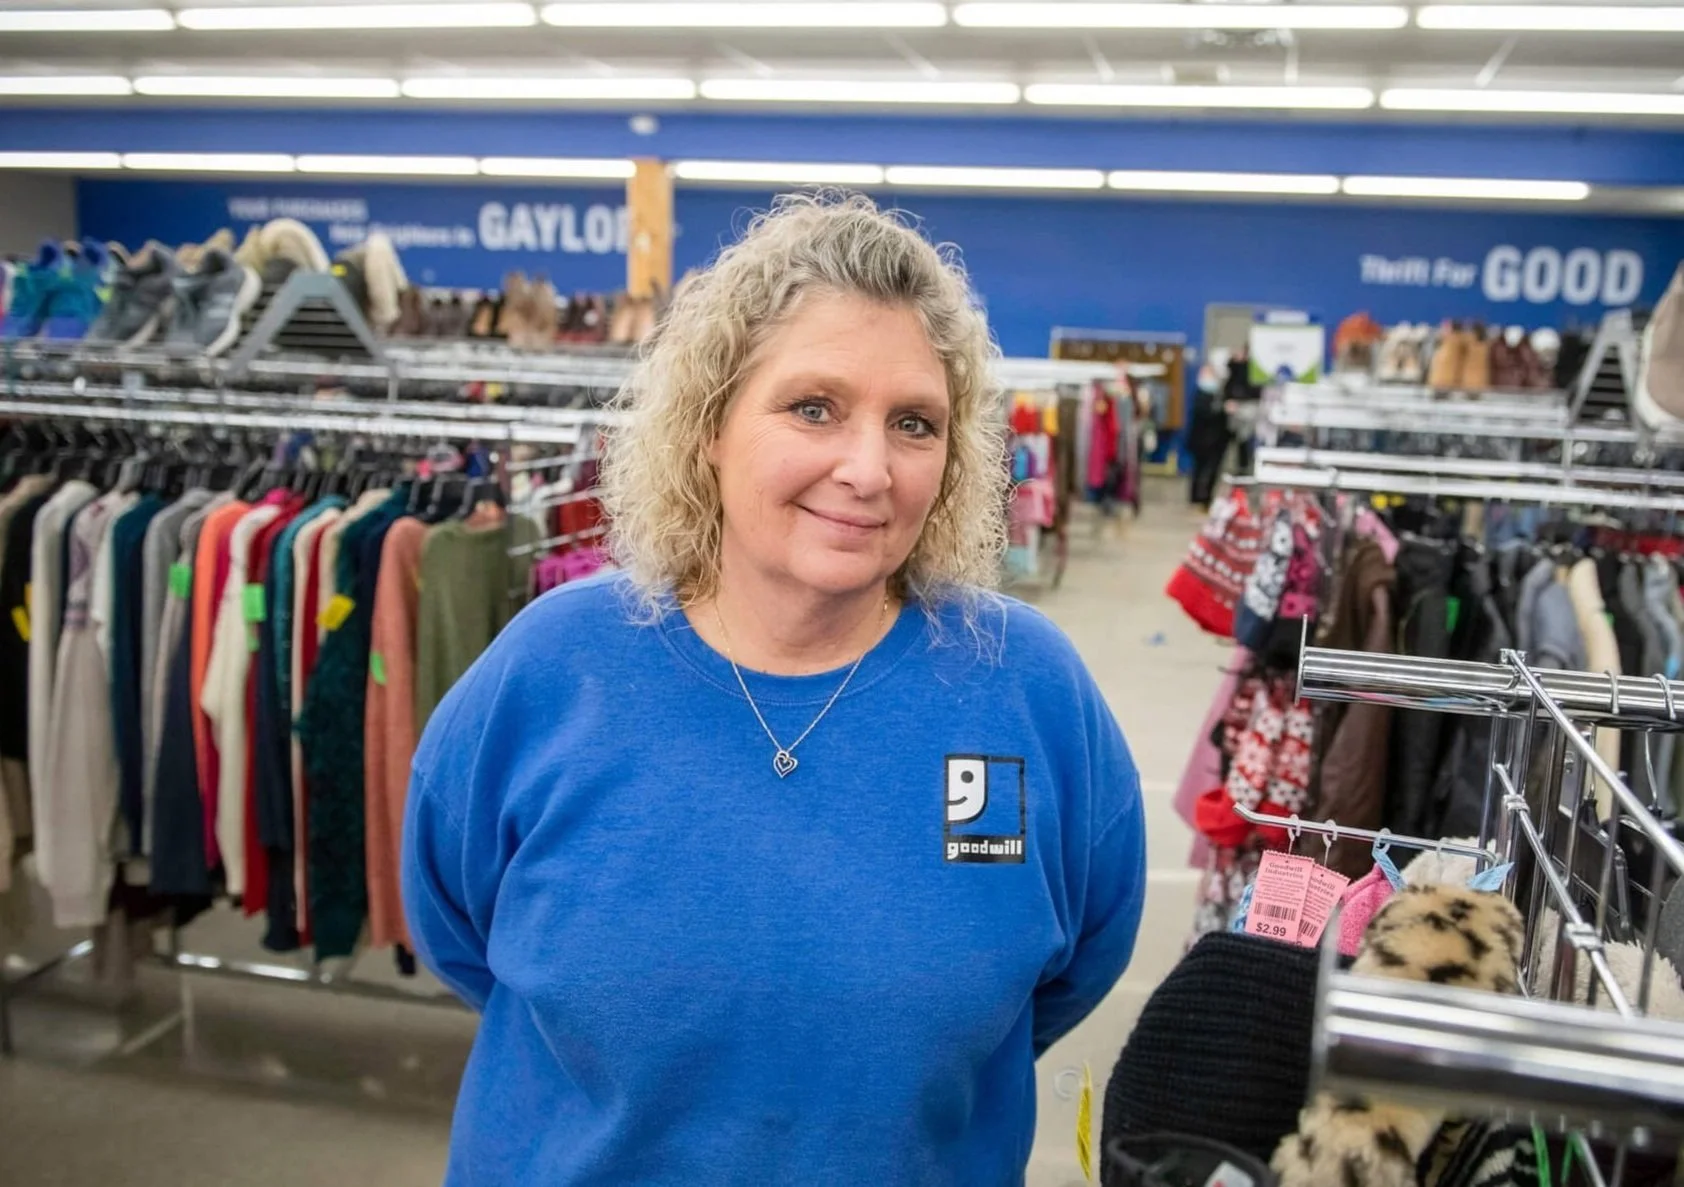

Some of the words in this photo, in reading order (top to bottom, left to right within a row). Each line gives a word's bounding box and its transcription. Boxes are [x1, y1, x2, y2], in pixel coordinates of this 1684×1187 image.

[1360, 254, 1429, 287] Thrift
[1432, 257, 1478, 288] For
[1482, 245, 1644, 306] GOOD
[947, 840, 1022, 860] goodwill
[1269, 862, 1303, 873] Goodwill
[1256, 922, 1287, 937] $2.99
